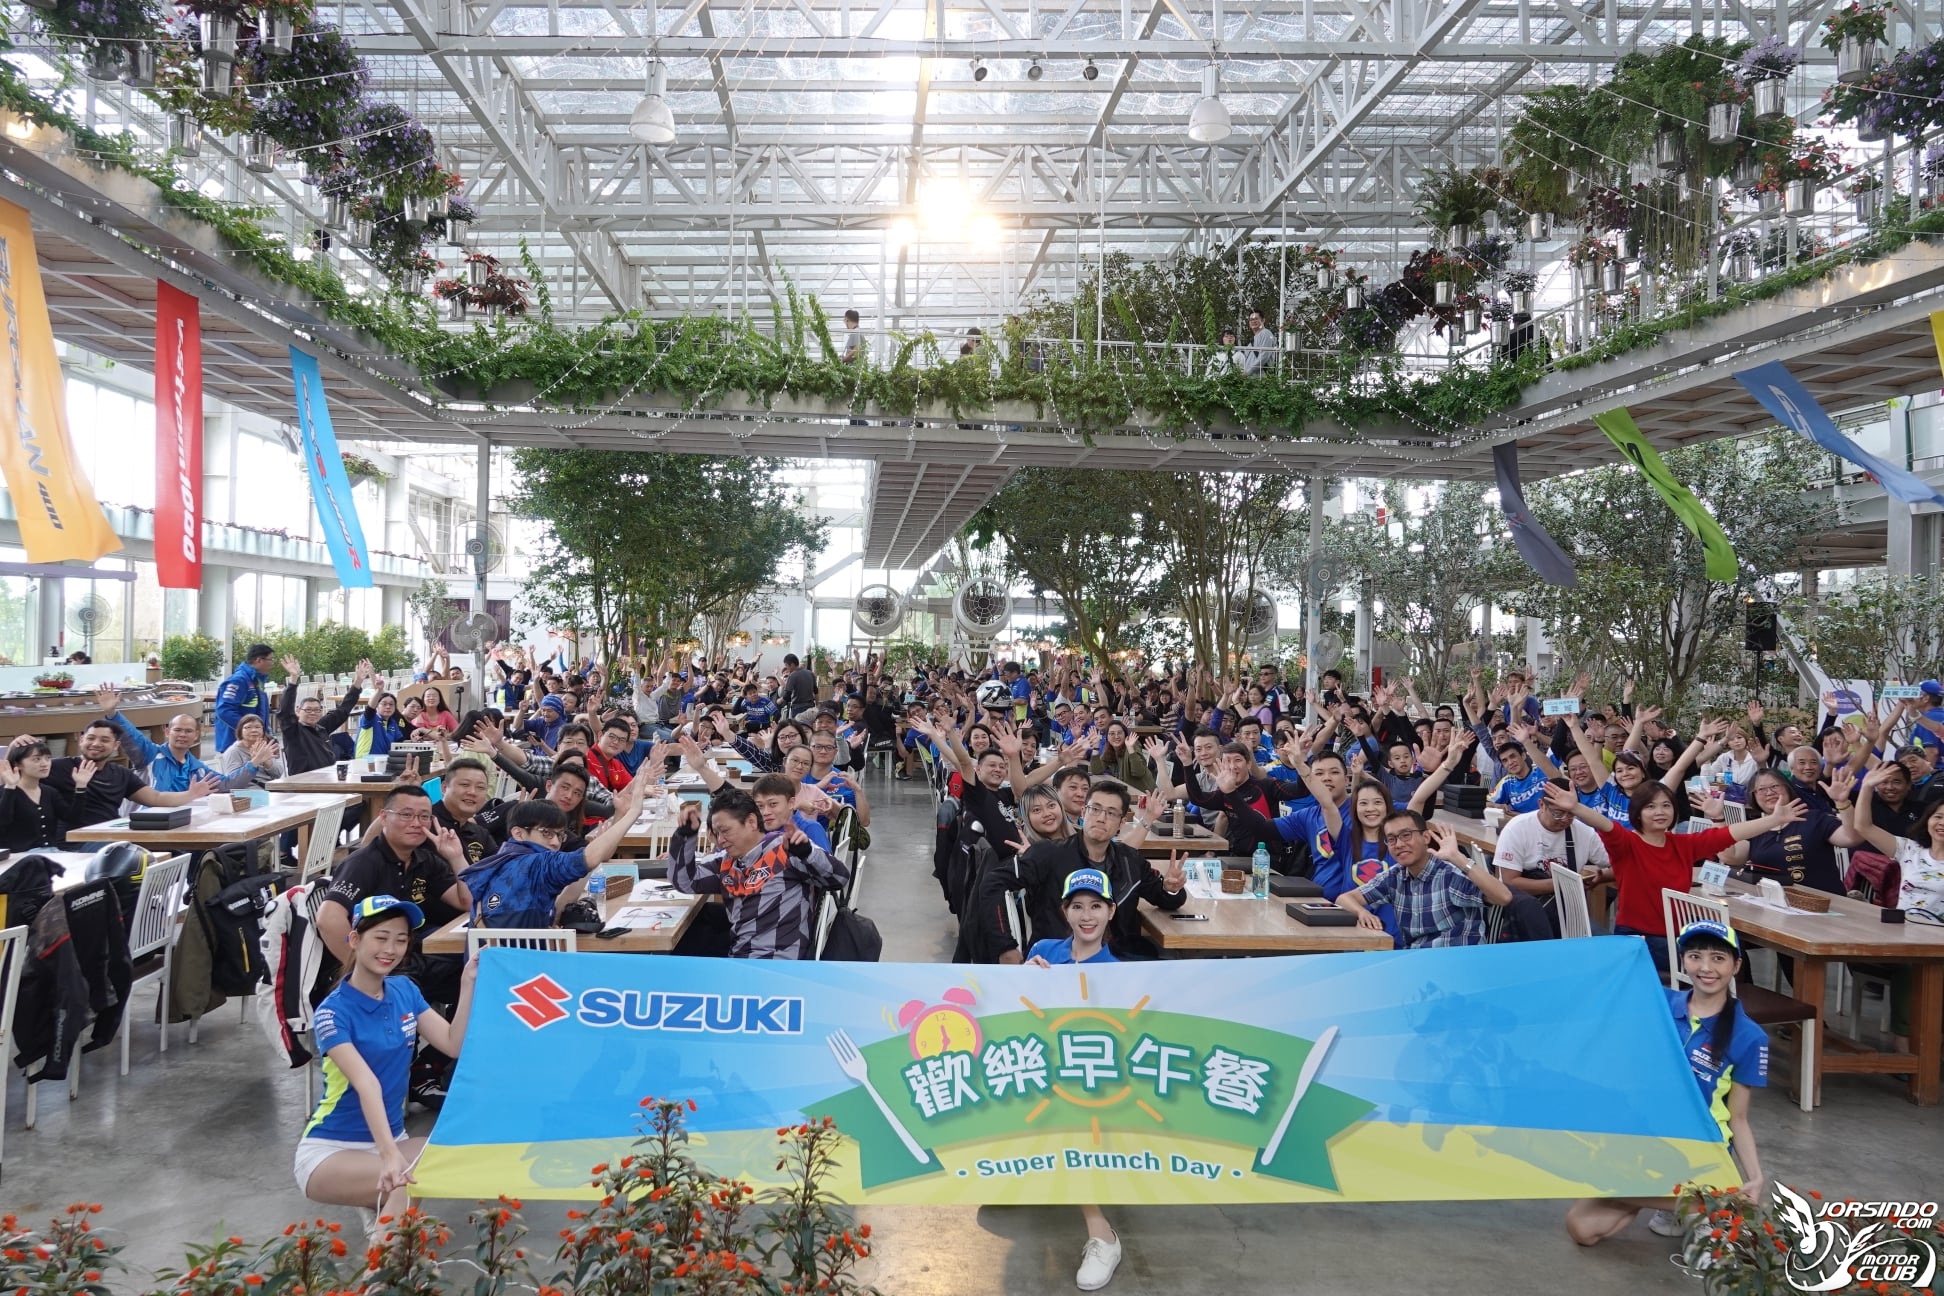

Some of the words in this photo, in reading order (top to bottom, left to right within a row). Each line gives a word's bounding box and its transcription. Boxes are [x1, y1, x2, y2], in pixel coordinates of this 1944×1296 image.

[1510, 781, 1545, 806] SUZUK
[577, 988, 804, 1034] SUZUKI
[905, 1033, 1271, 1118] 歡樂早午餐
[976, 1154, 1056, 1177] Super
[1064, 1149, 1161, 1171] Brunch
[1170, 1154, 1222, 1179] Day
